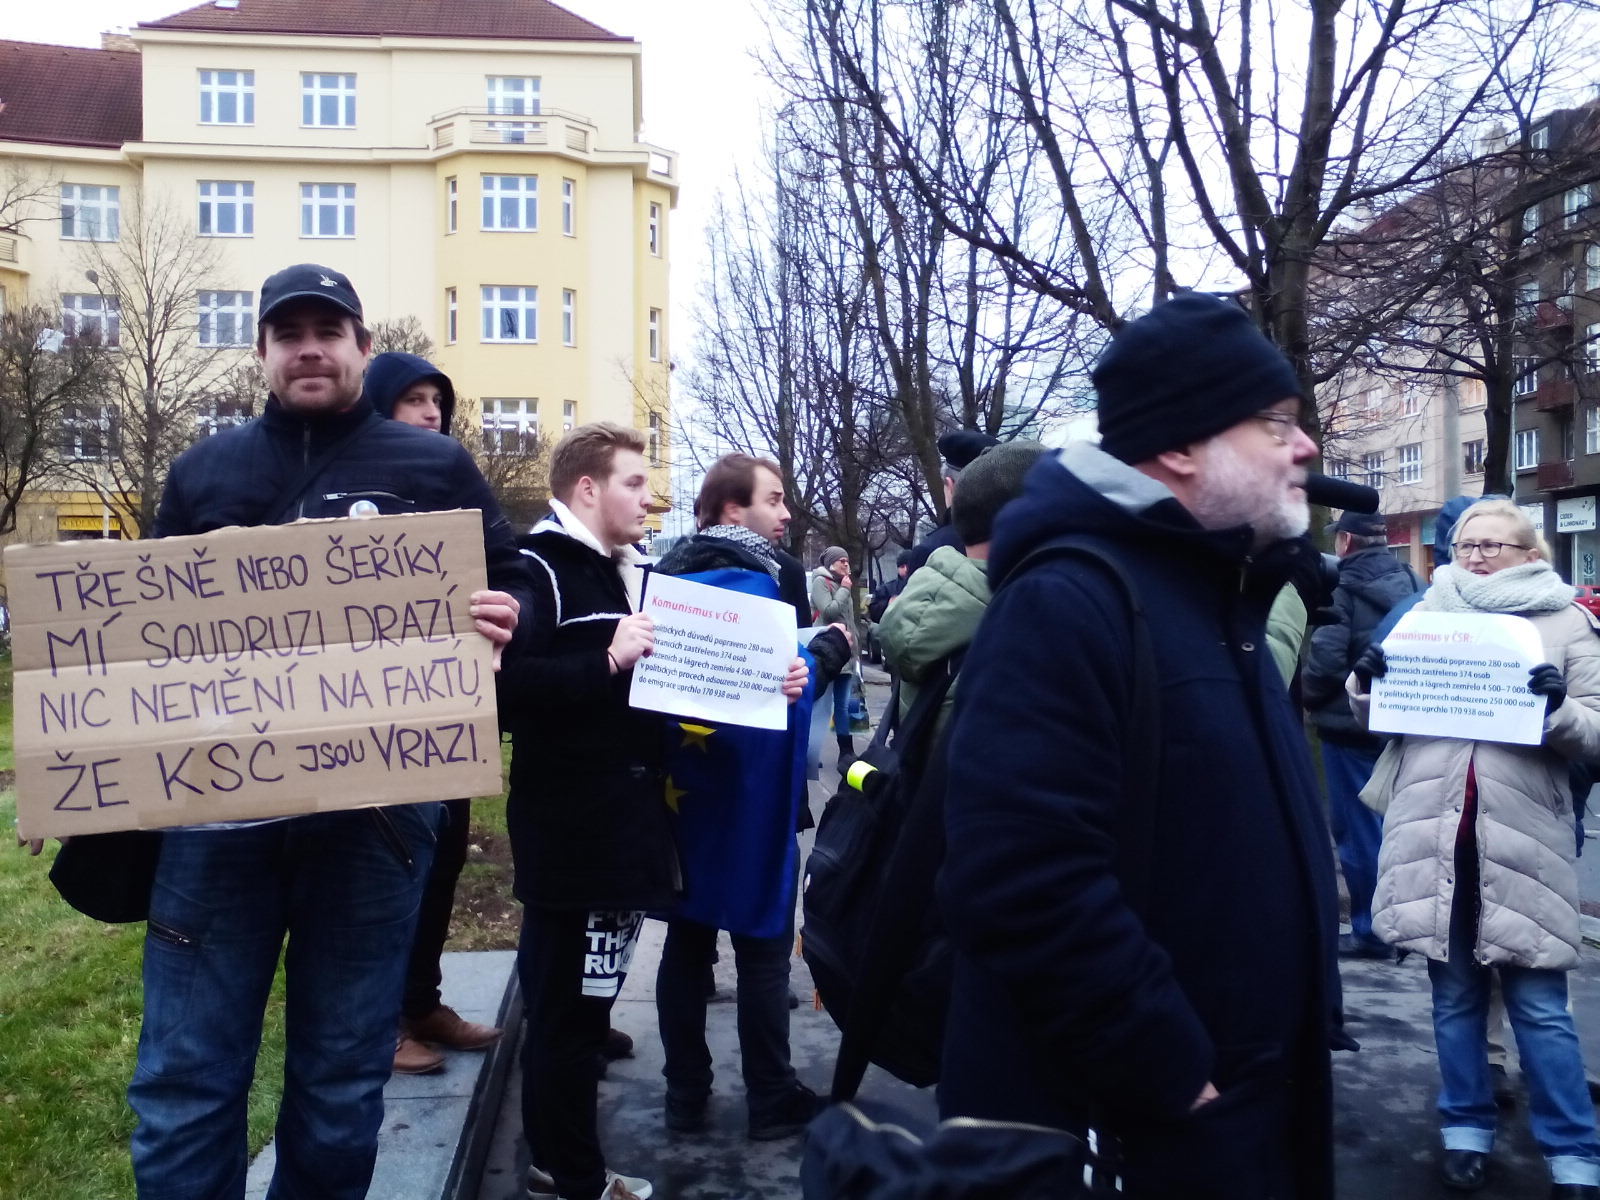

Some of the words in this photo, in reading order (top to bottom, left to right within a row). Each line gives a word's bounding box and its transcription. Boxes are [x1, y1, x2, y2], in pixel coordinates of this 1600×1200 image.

[36, 546, 225, 612] TŘEŠNĚ
[236, 553, 308, 593] NEBO
[326, 532, 448, 585] ŠEŘÍKY,
[652, 595, 713, 618] Komunismus
[715, 611, 721, 620] v
[46, 611, 122, 678] MÍ
[141, 609, 326, 669] SOUDRUZI
[344, 584, 463, 650] DRAZÍ,
[687, 628, 713, 643] důvodů
[714, 636, 747, 651] popraveno
[748, 642, 759, 652] 280
[760, 645, 774, 655] osob
[1390, 632, 1441, 642] omunismus
[720, 650, 732, 660] 374
[732, 654, 747, 663] osob
[1448, 657, 1487, 667] popraveno
[1488, 659, 1501, 667] 280
[1503, 660, 1521, 668] osob
[678, 670, 705, 683] procech
[705, 675, 738, 688] odsouzeno
[739, 680, 751, 689] 250
[751, 683, 762, 692] 000
[763, 685, 777, 694] osob
[761, 671, 772, 680] 000
[772, 674, 786, 683] osob
[1459, 670, 1472, 678] 374
[40, 688, 111, 735] NIC
[132, 663, 299, 726] NEMĚNÍ
[319, 669, 374, 712] NA
[382, 657, 482, 708] FAKTU,
[638, 675, 647, 684] do
[647, 678, 677, 690] emigrace
[677, 682, 701, 695] uprchlo
[702, 686, 714, 696] 170
[714, 688, 726, 698] 938
[726, 690, 741, 700] osob
[1512, 686, 1526, 695] 000
[1378, 701, 1387, 709] do
[1388, 703, 1420, 713] emigrace
[1421, 704, 1448, 714] uprchlo
[1450, 706, 1463, 714] 170
[1463, 708, 1476, 716] 938
[1477, 709, 1495, 717] osob
[1422, 692, 1449, 702] procech
[1450, 694, 1488, 705] odsouzeno
[1489, 696, 1503, 705] 250
[1504, 698, 1517, 706] 000
[1518, 699, 1536, 708] osob
[46, 750, 130, 812] ŽE
[156, 720, 285, 800] KSČ
[369, 722, 488, 771] VRAZI.
[585, 928, 630, 952] THE
